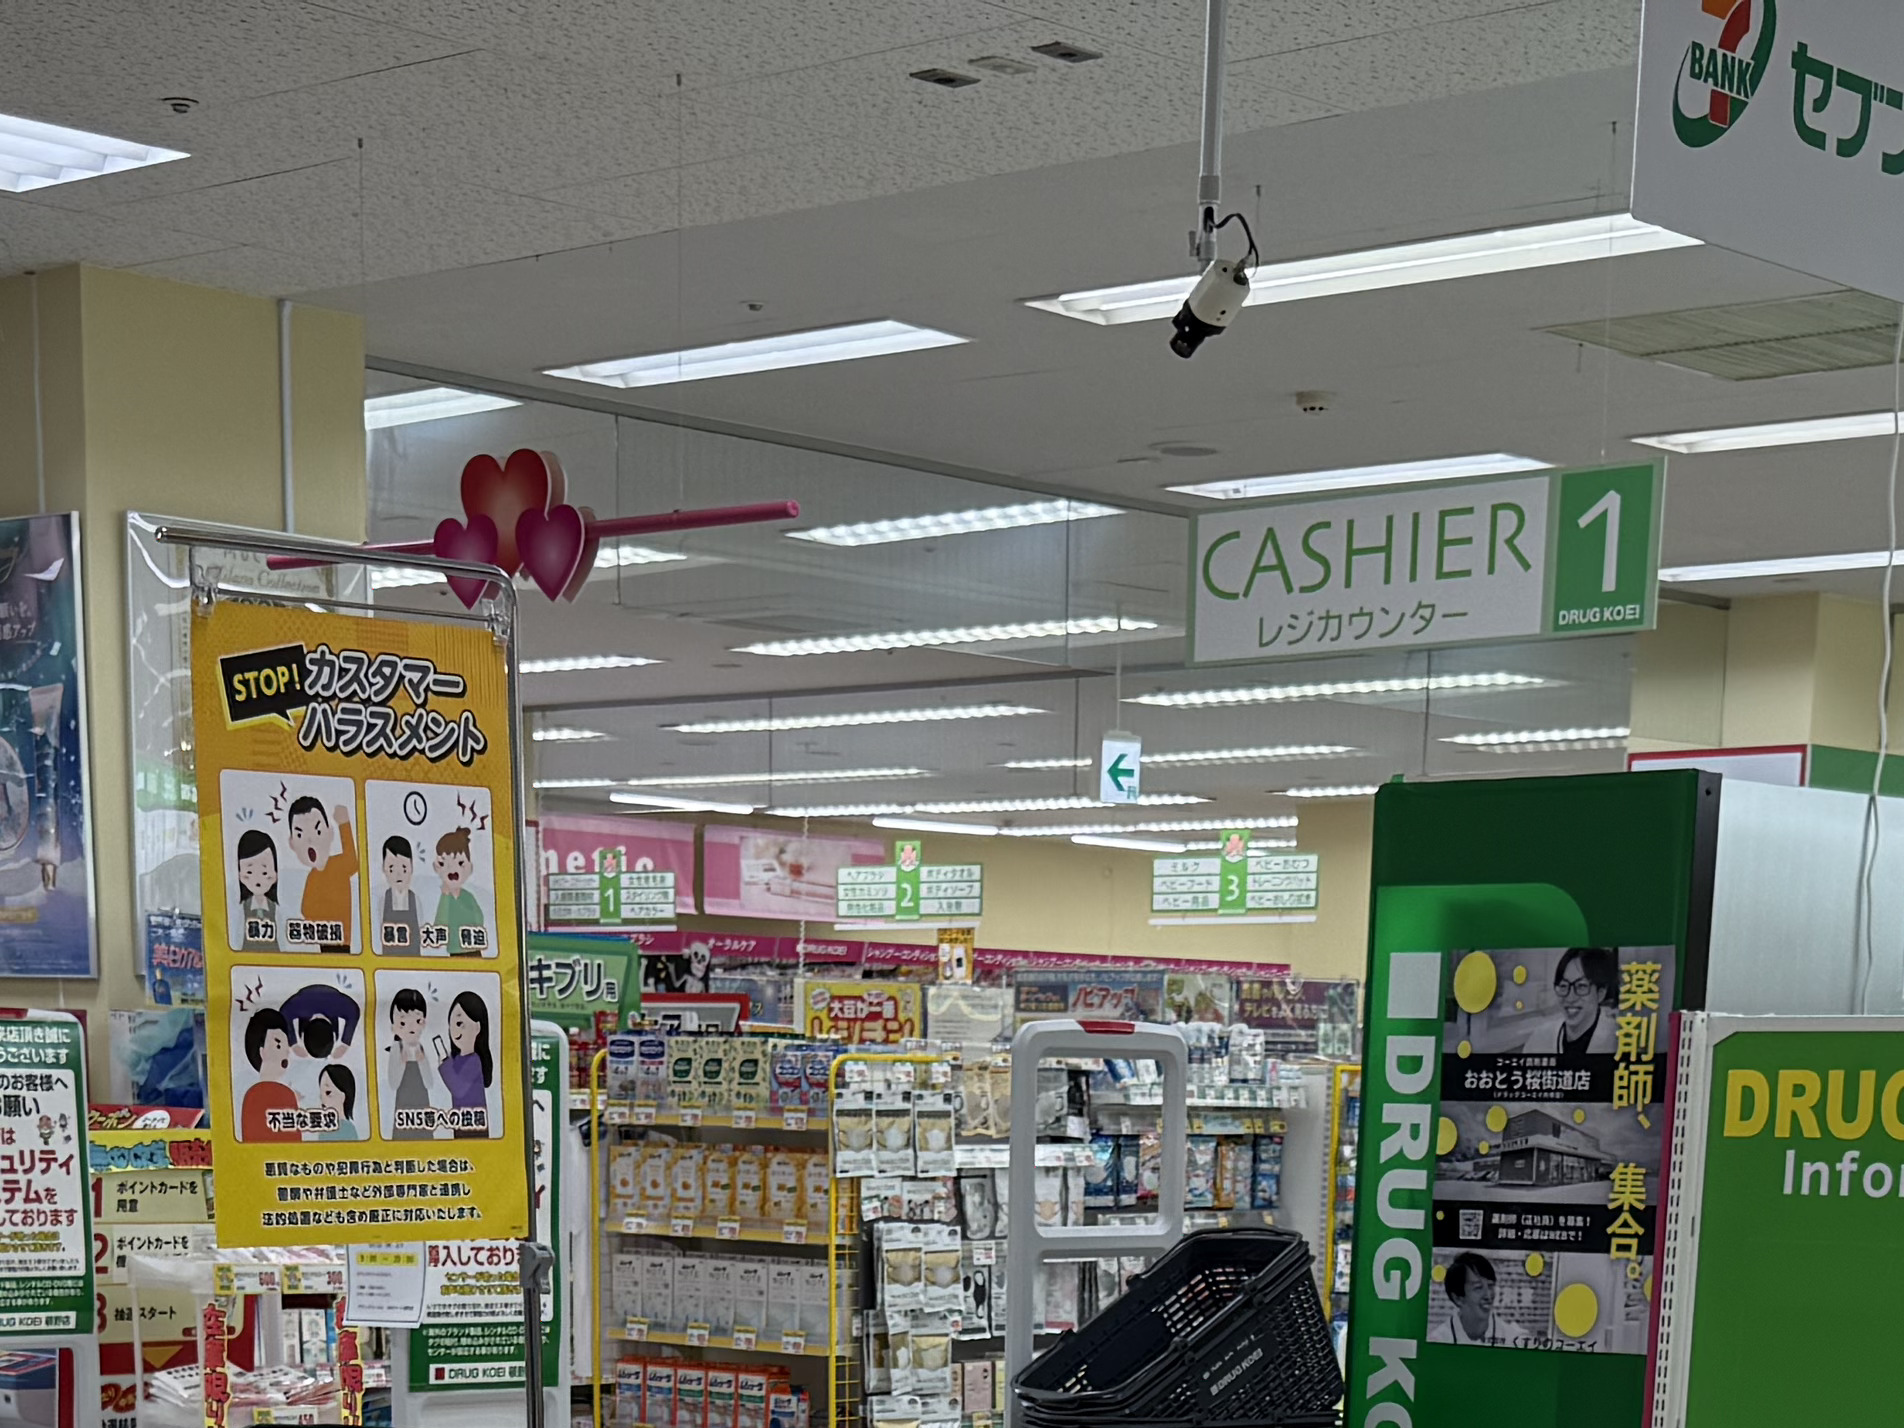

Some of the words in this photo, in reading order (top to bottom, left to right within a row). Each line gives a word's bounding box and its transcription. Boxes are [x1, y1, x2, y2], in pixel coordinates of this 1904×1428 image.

[1689, 41, 1754, 100] BANK
[1202, 502, 1532, 601] CASHIER
[1577, 490, 1621, 592] 1
[1259, 600, 1468, 648] レジカウンター
[1558, 605, 1600, 625] DRUG
[1602, 603, 1640, 623] KOEI
[233, 664, 301, 702] STOP!
[304, 645, 465, 704] カスタマー
[299, 702, 488, 763] ハラスメント
[604, 888, 614, 913] 1
[900, 882, 915, 908] 2
[1225, 875, 1241, 902] 3
[248, 921, 276, 940] 暴力
[288, 920, 344, 942] 器物破損
[422, 926, 449, 946] 大声
[1464, 1069, 1592, 1090] おおとう桜街道店
[266, 1109, 339, 1130] 不当な要求
[396, 1109, 487, 1129] SNS等への投稿
[1373, 1035, 1437, 1301] DRUG
[116, 1180, 199, 1195] ポイントカードを
[1606, 1163, 1648, 1280] 集合。
[116, 1236, 190, 1251] ポイントカードを
[448, 1367, 480, 1380] DRUG
[482, 1366, 507, 1379] KOEI
